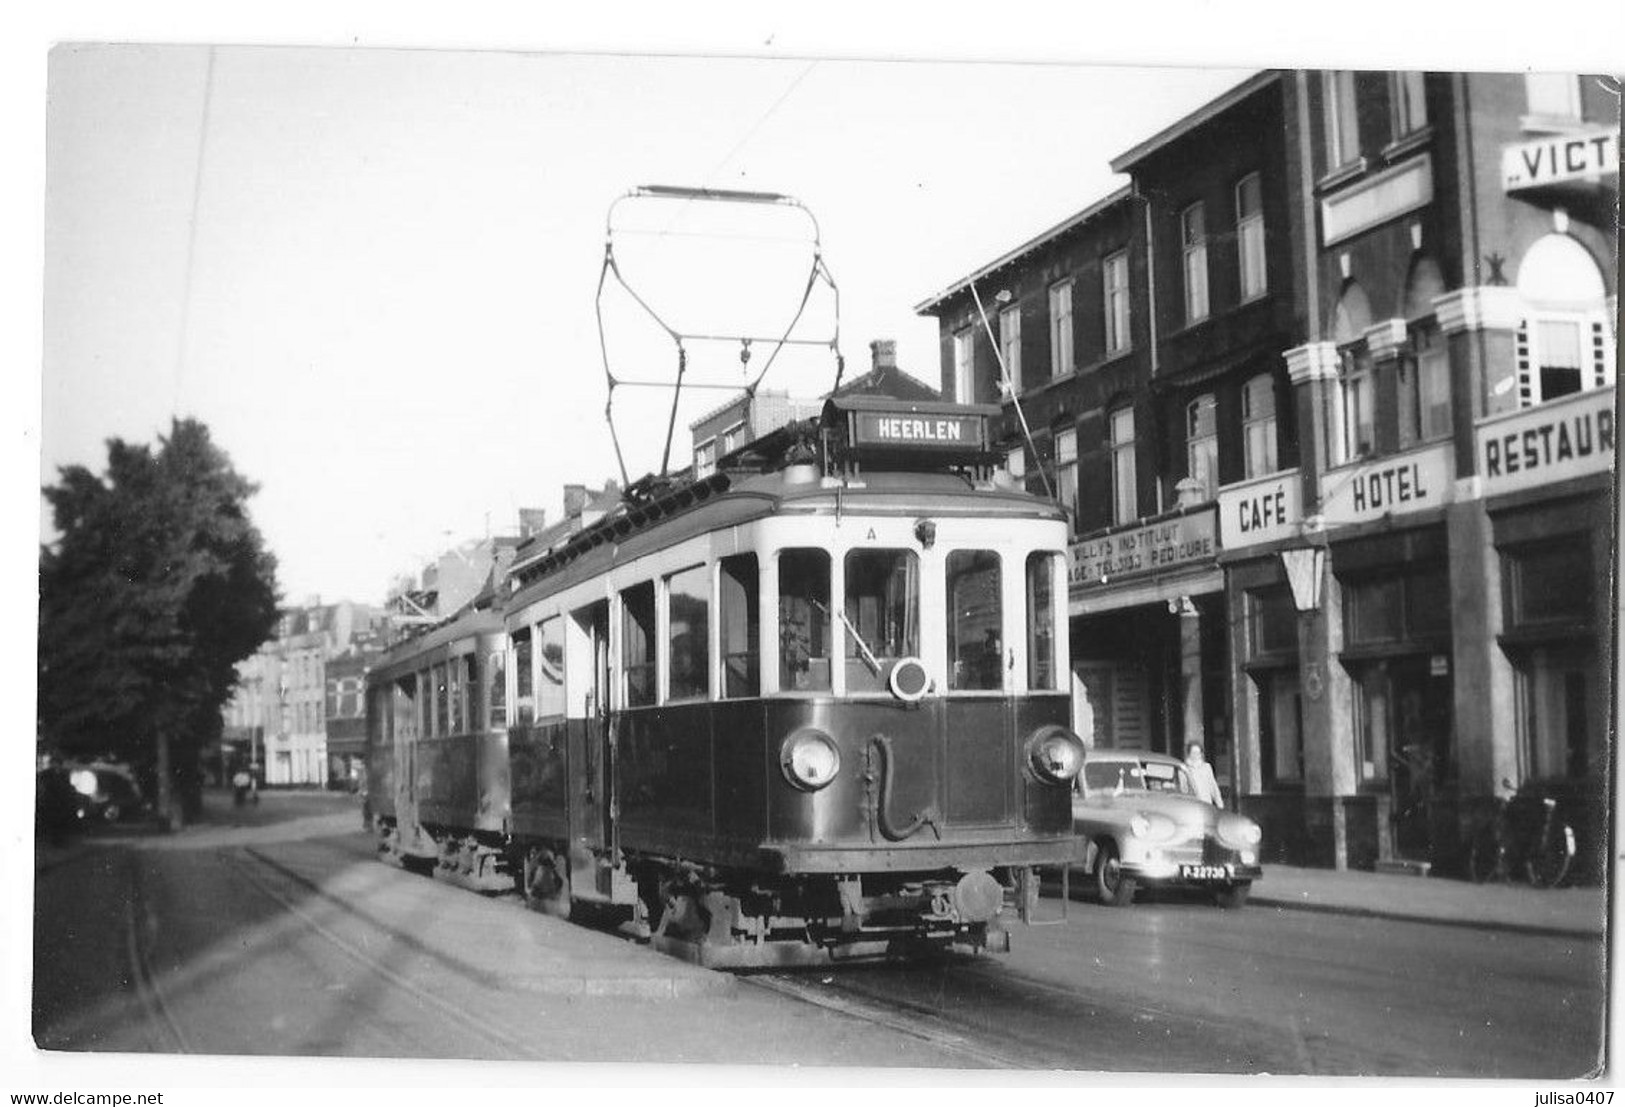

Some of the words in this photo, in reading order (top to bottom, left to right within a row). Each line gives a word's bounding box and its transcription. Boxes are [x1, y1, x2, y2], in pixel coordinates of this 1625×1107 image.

[878, 417, 961, 441] HEERLEN
[1485, 408, 1614, 478] RESTAUR
[1352, 463, 1427, 512] HOTEL
[1238, 484, 1286, 533] CAFÉ
[867, 527, 877, 540] A
[1151, 537, 1211, 567] PEDICURE
